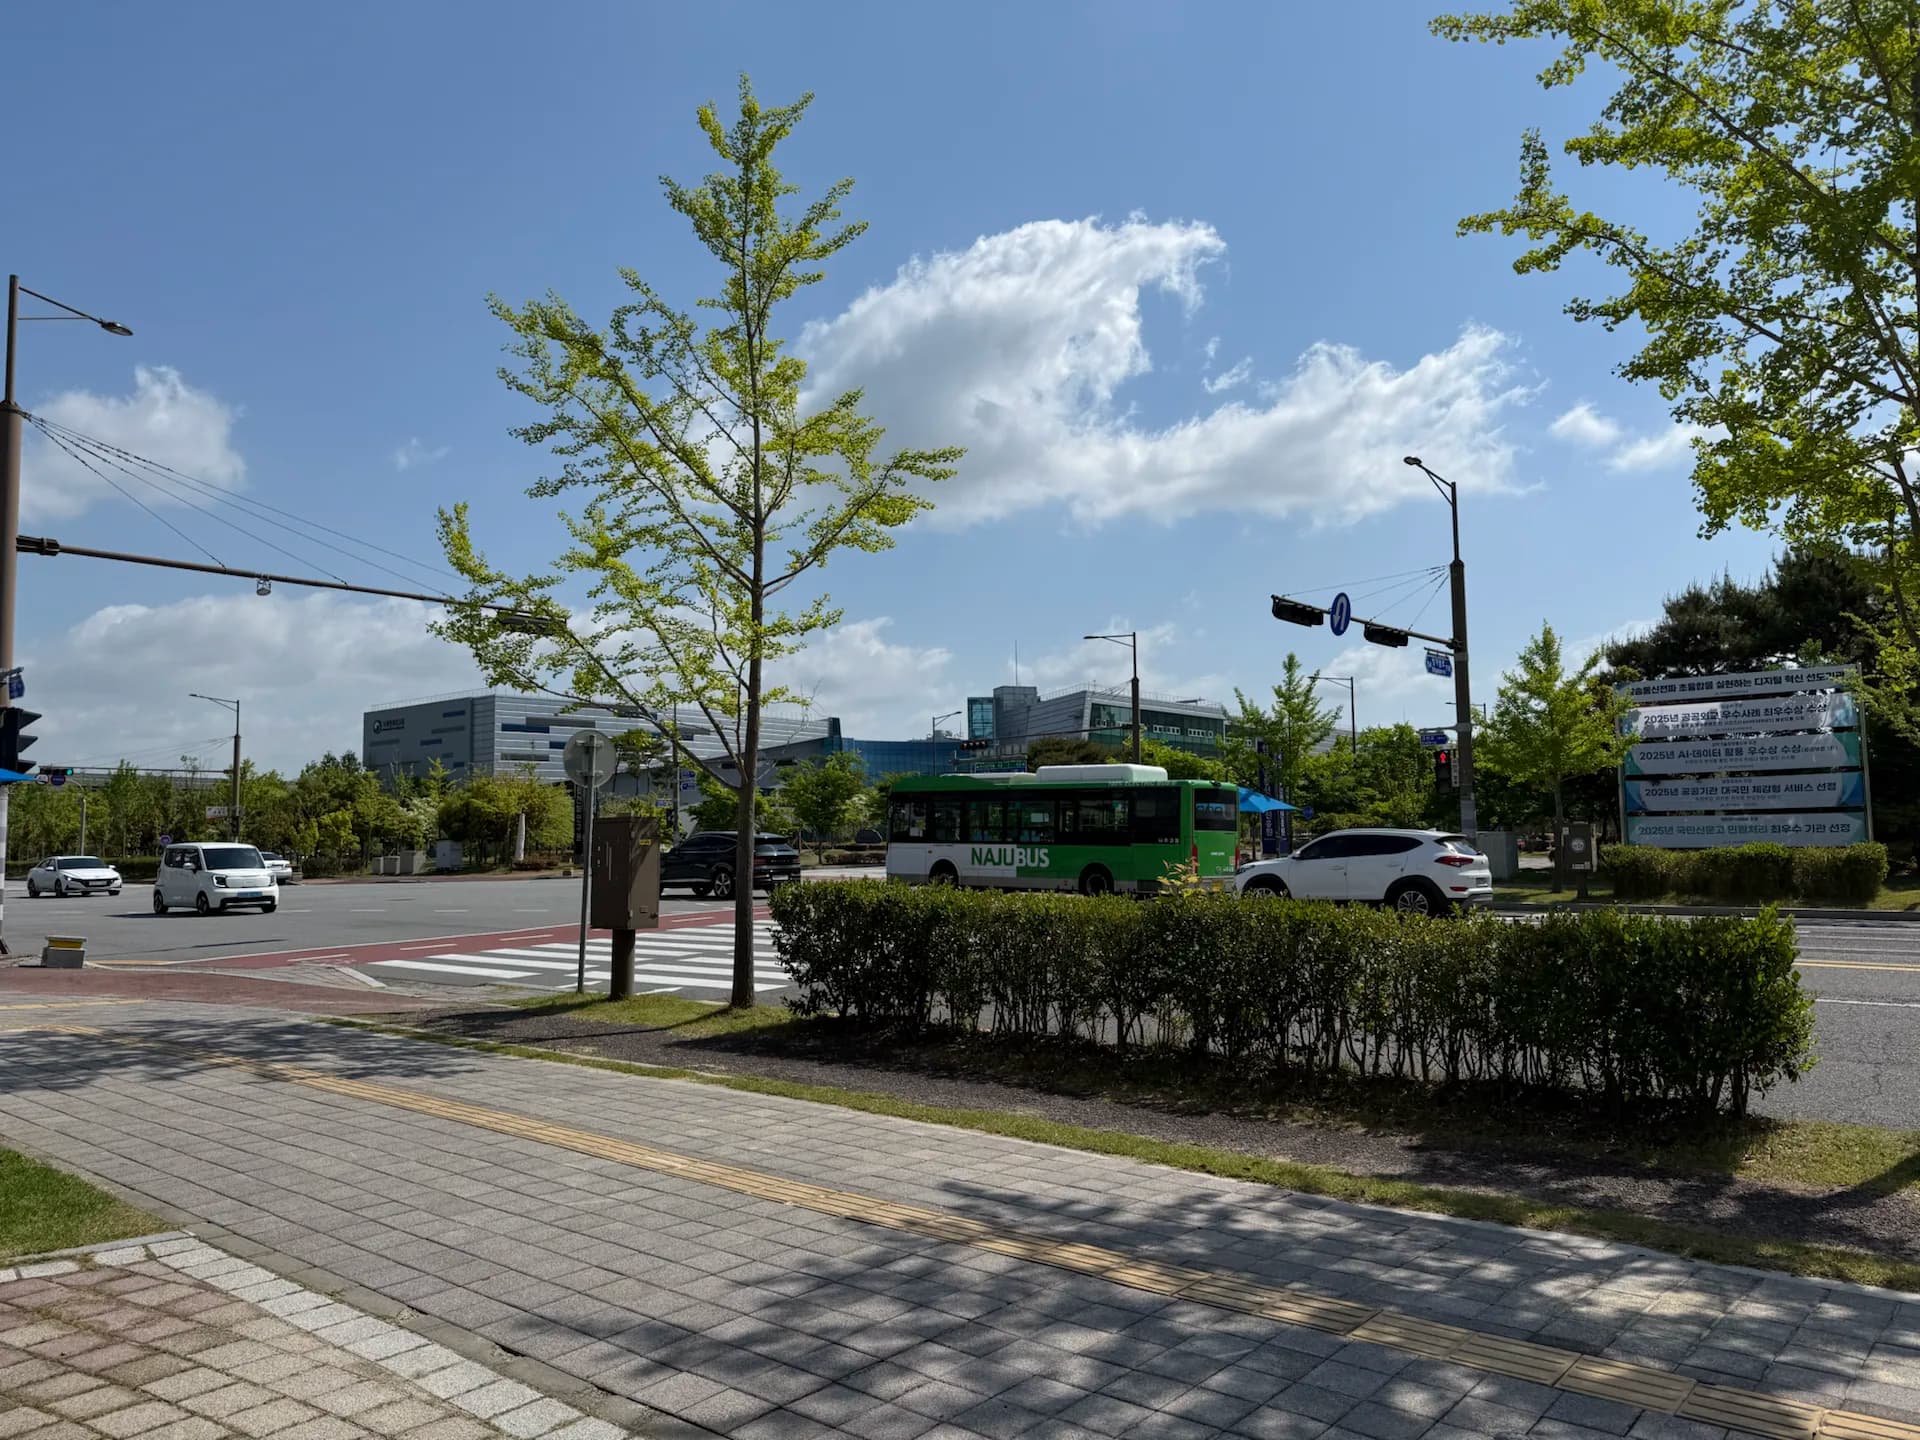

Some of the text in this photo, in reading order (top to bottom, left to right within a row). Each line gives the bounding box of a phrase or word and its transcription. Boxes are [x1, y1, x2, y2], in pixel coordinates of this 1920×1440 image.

[1716, 678, 1752, 689] 실현하는
[1755, 676, 1782, 685] 디지털
[1785, 674, 1804, 683] 혁신
[1644, 713, 1679, 724] 2025년
[1681, 711, 1719, 721] 공공외교
[1721, 709, 1760, 719] 우수사례
[1763, 706, 1803, 716] 최우수상
[1807, 704, 1827, 713] 수상
[1640, 751, 1675, 760] 2025년
[1678, 748, 1721, 758] AI·데이터
[1748, 745, 1777, 755] 우수상
[1645, 782, 1836, 796] 2025년 공공기관 대국민 체감형 서비스 선정
[1638, 826, 1673, 835] 2025년
[1676, 825, 1725, 834] 국민신문고
[1770, 824, 1801, 833] 최우수
[1804, 824, 1826, 832] 기관
[1830, 823, 1850, 833] 선정
[971, 848, 1050, 868] NAJUBUS
